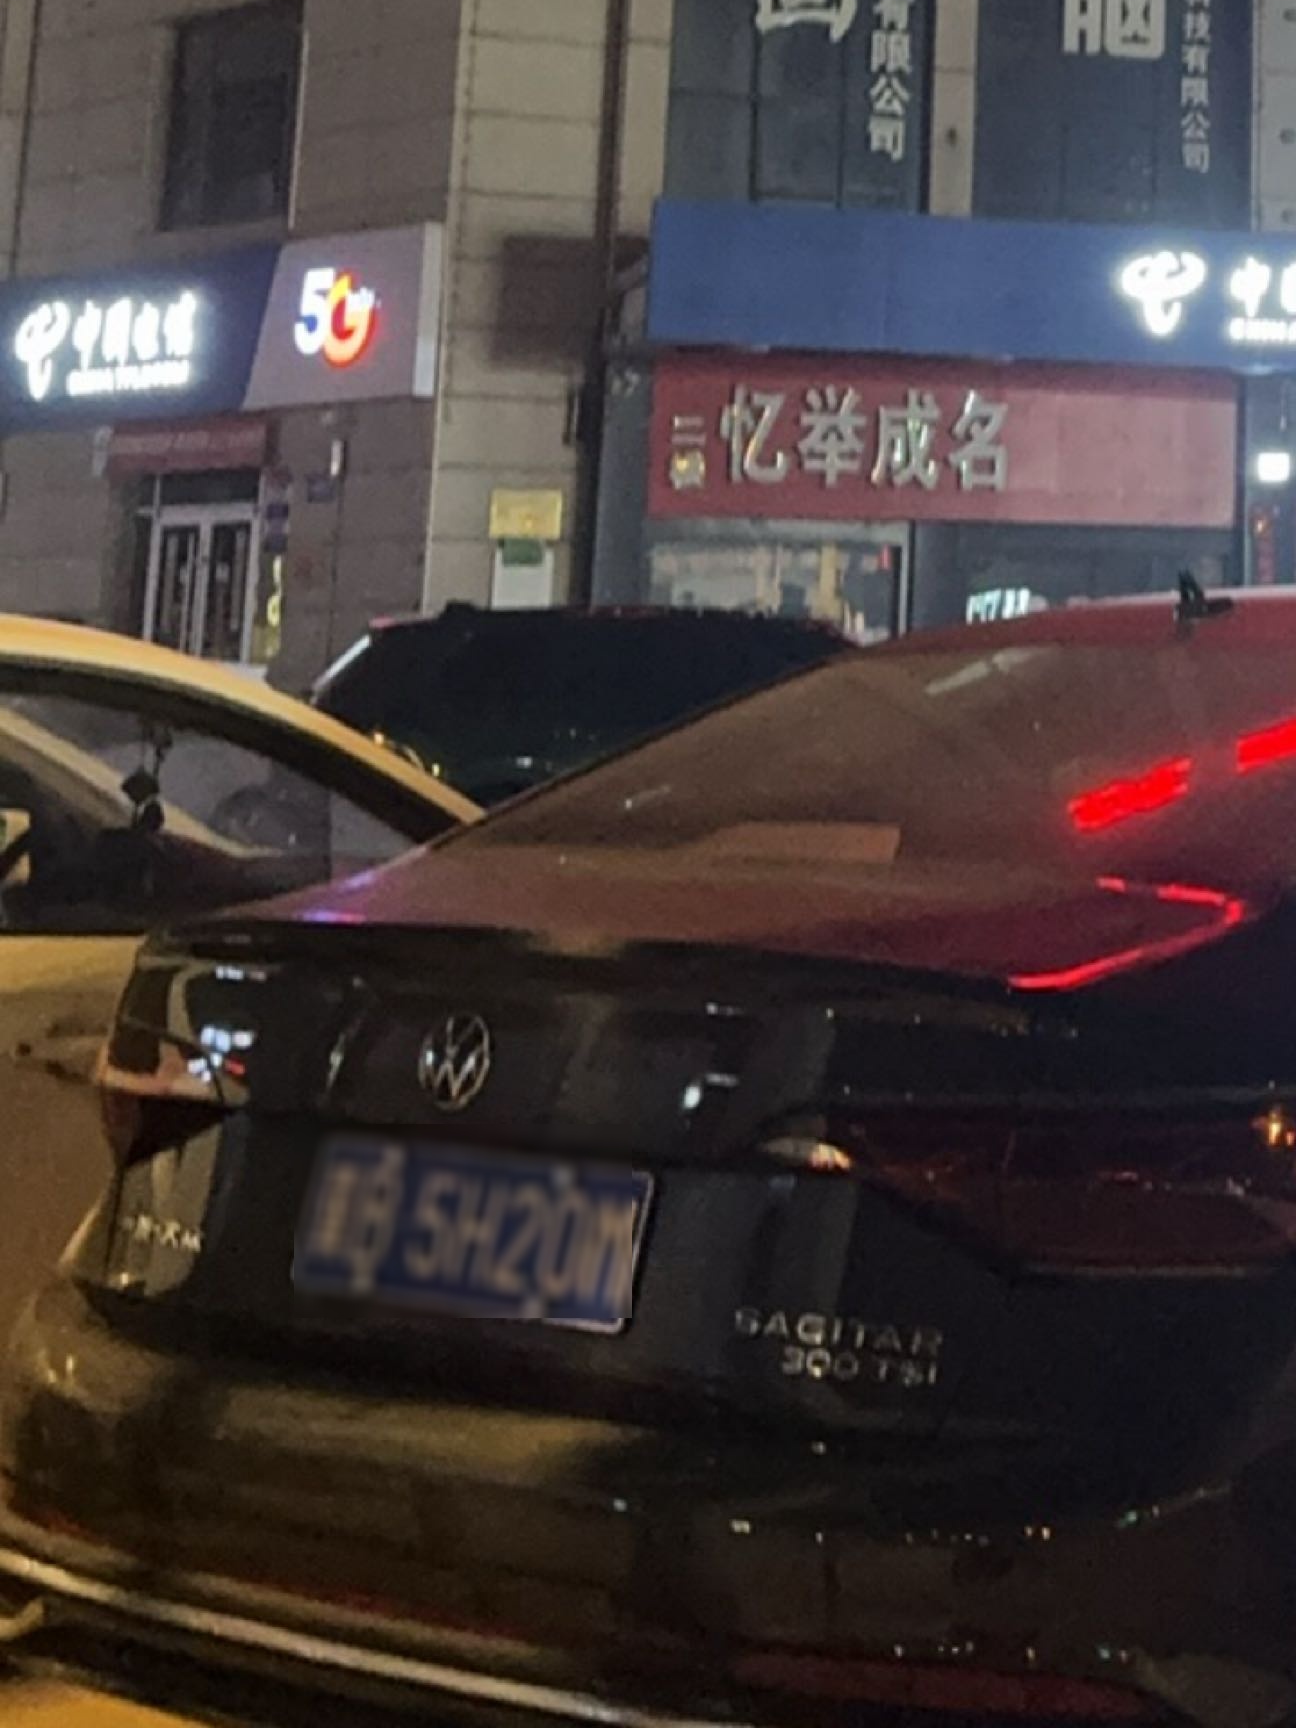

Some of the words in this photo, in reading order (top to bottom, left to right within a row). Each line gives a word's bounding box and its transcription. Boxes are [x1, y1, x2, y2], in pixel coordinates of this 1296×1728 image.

[294, 267, 378, 368] 5G
[720, 382, 1009, 492] 忆举成名
